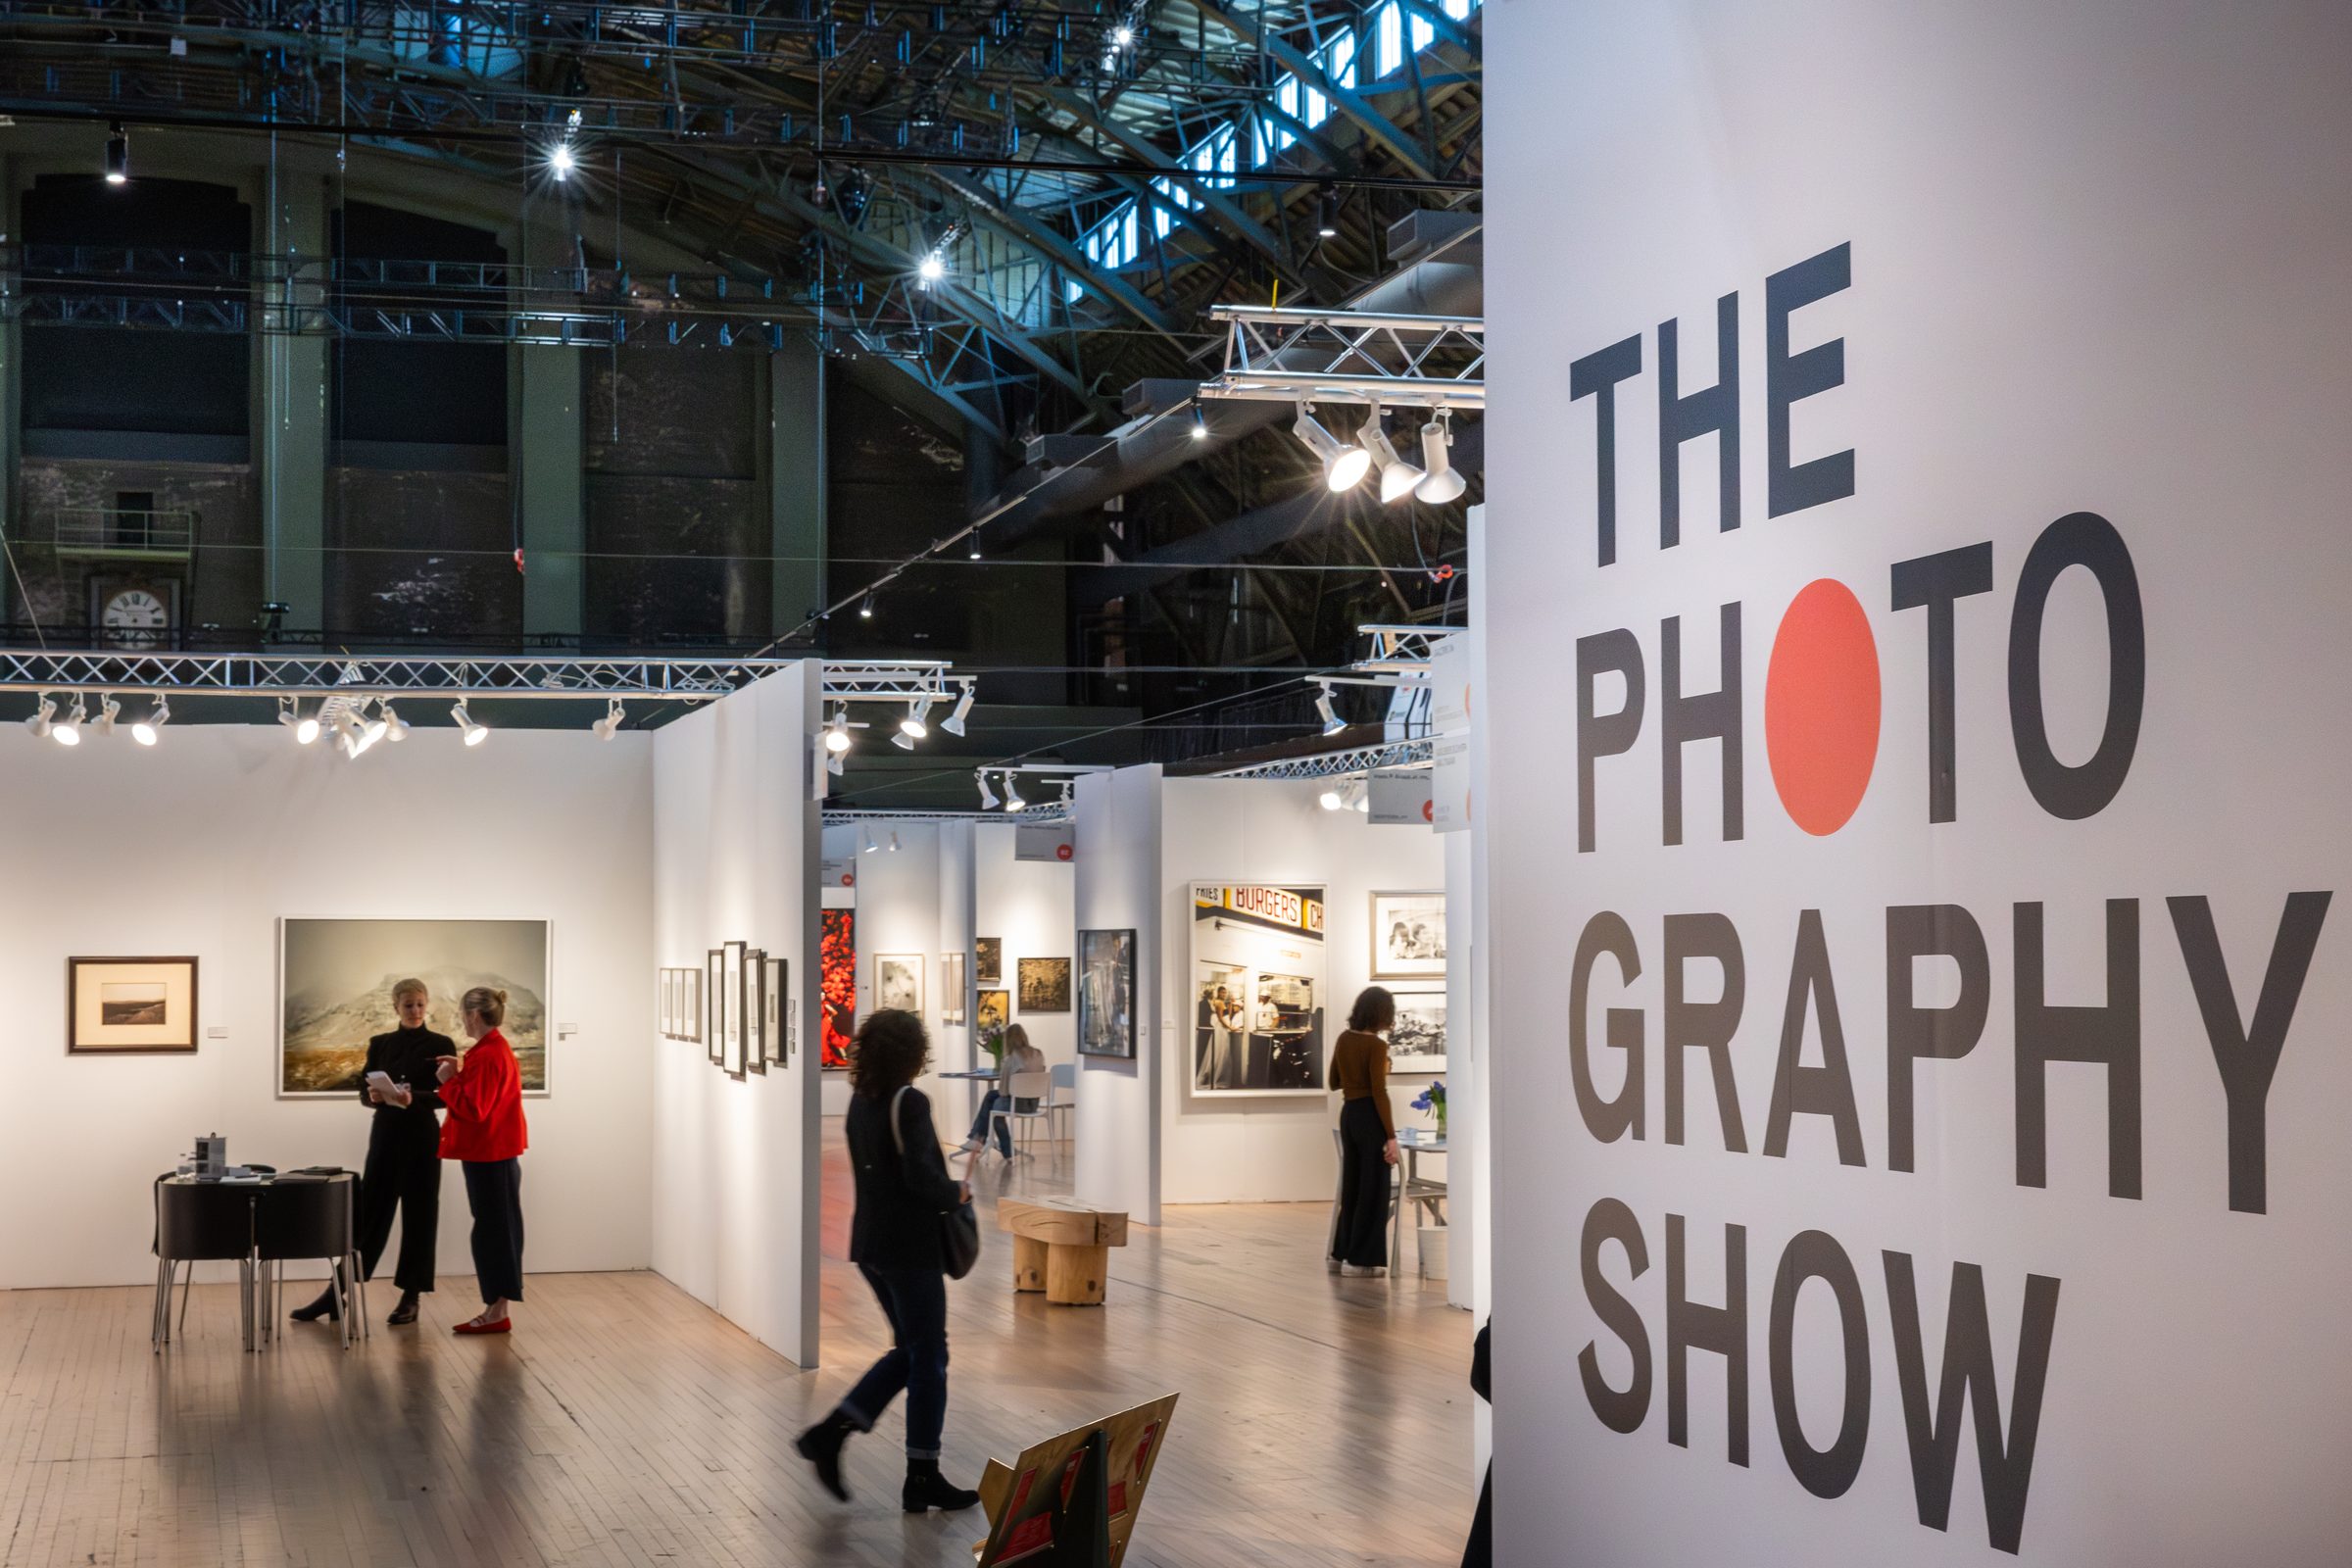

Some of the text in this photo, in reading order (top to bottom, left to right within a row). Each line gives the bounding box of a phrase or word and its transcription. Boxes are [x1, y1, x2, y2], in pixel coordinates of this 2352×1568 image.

[1570, 241, 1855, 568] THE
[1576, 511, 2146, 854] PHOTO
[1236, 887, 1298, 922] BURGERS
[1569, 890, 2334, 1216] GRAPHY
[1577, 1197, 2062, 1556] SHOW
